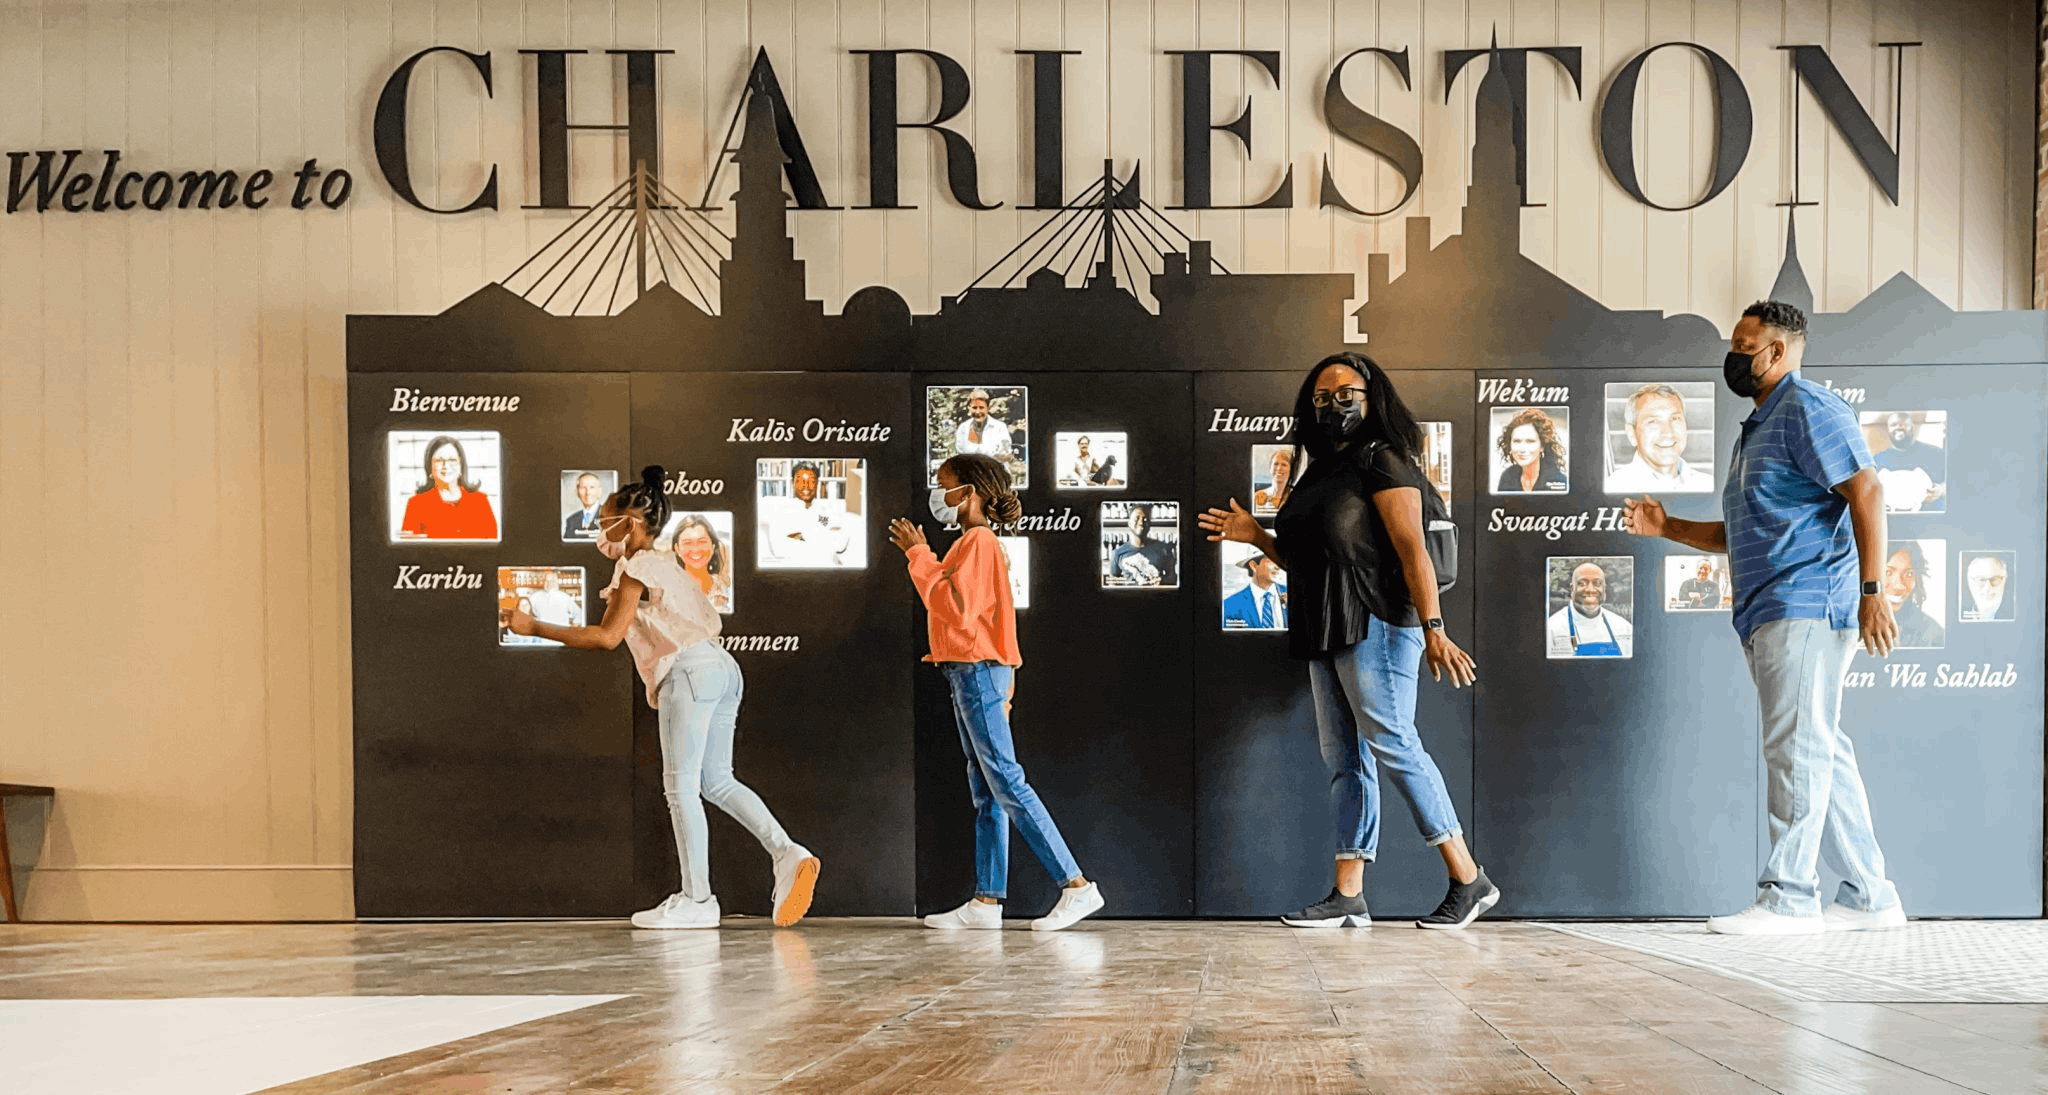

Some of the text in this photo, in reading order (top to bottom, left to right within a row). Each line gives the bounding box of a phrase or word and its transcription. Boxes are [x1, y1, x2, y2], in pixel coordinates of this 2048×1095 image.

[5, 41, 1922, 216] Welcome to CHARLESTON
[389, 387, 521, 412] Bienvenue
[1477, 378, 1570, 404] Wek’um
[726, 417, 892, 443] Kalōs Orisate
[1487, 507, 1590, 541] Svaagat
[393, 565, 483, 590] Karibu
[1933, 663, 2018, 688] Sahlab
